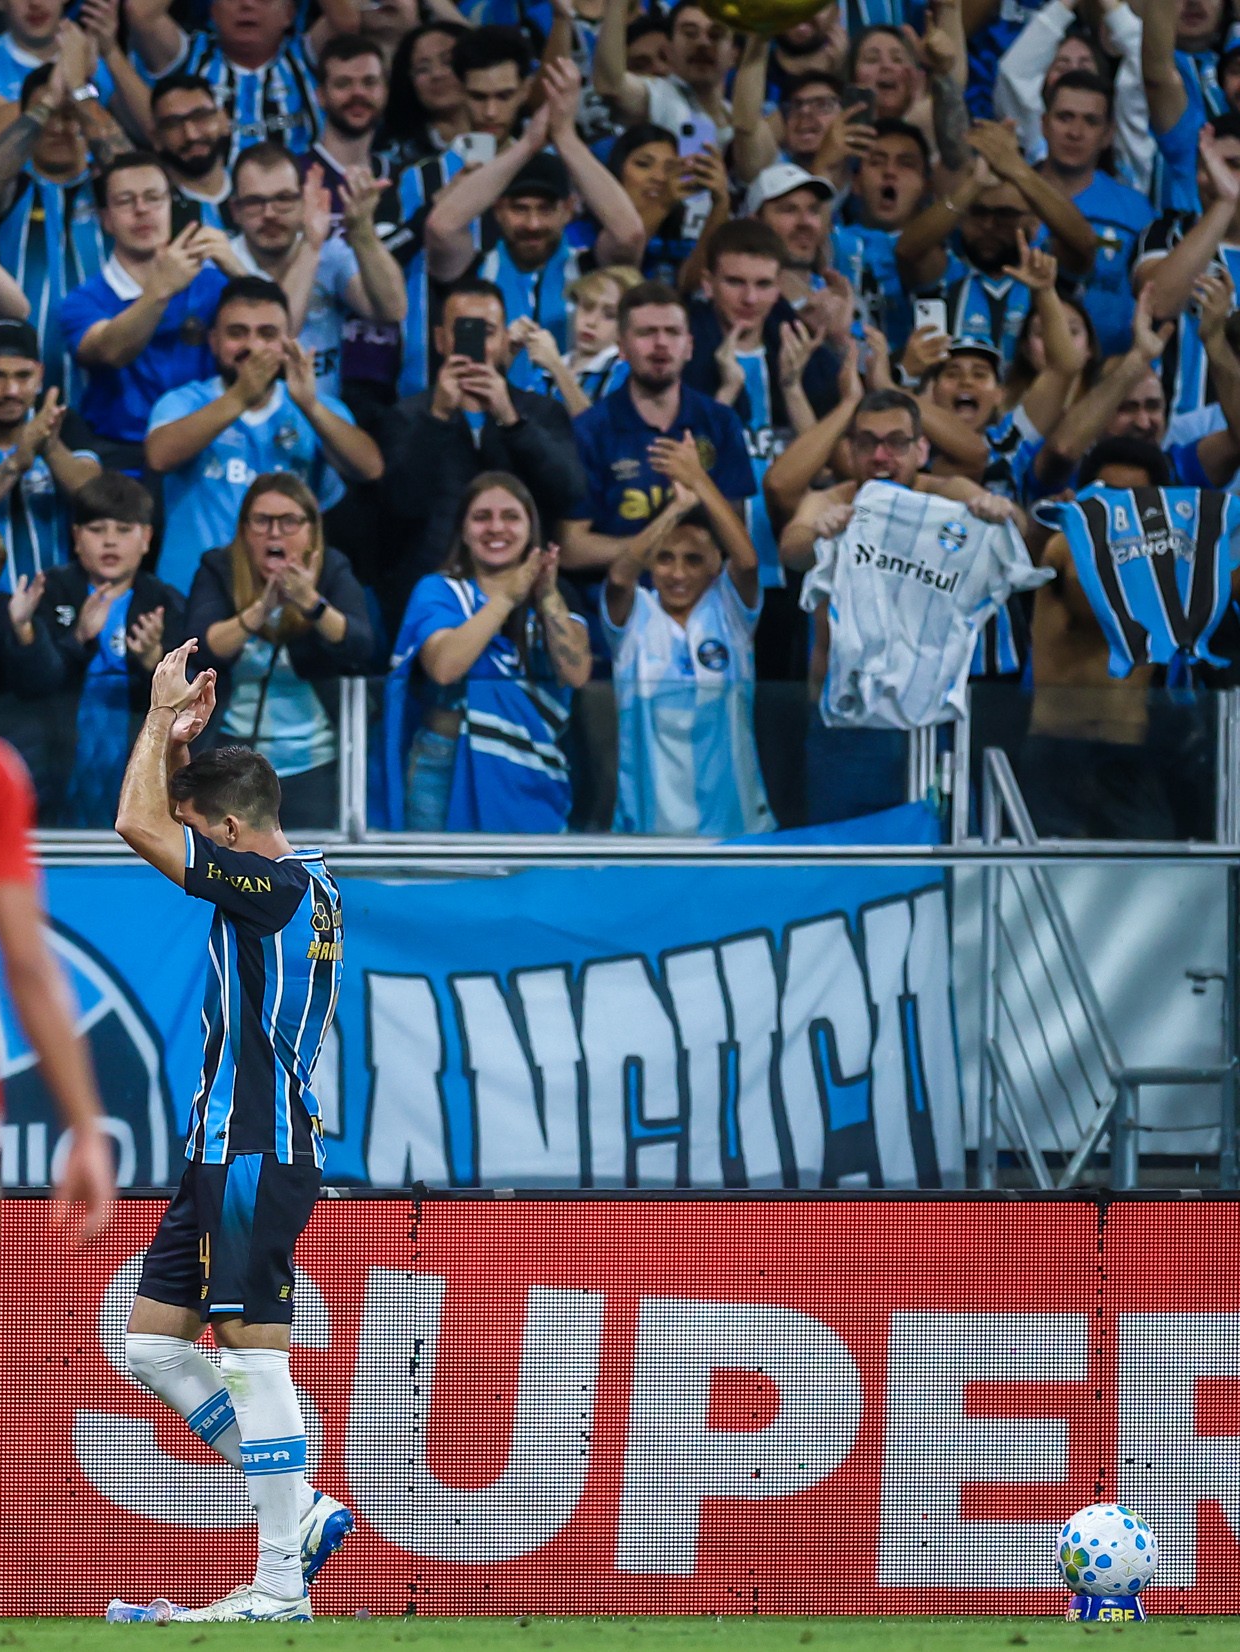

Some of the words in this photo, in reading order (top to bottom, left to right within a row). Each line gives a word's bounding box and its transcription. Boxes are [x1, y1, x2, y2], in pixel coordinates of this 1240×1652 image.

[854, 543, 960, 594] anrisul
[206, 862, 272, 893] HVAN
[199, 1231, 211, 1280] 4
[192, 1398, 235, 1437] FBP
[1098, 1607, 1135, 1622] CBF
